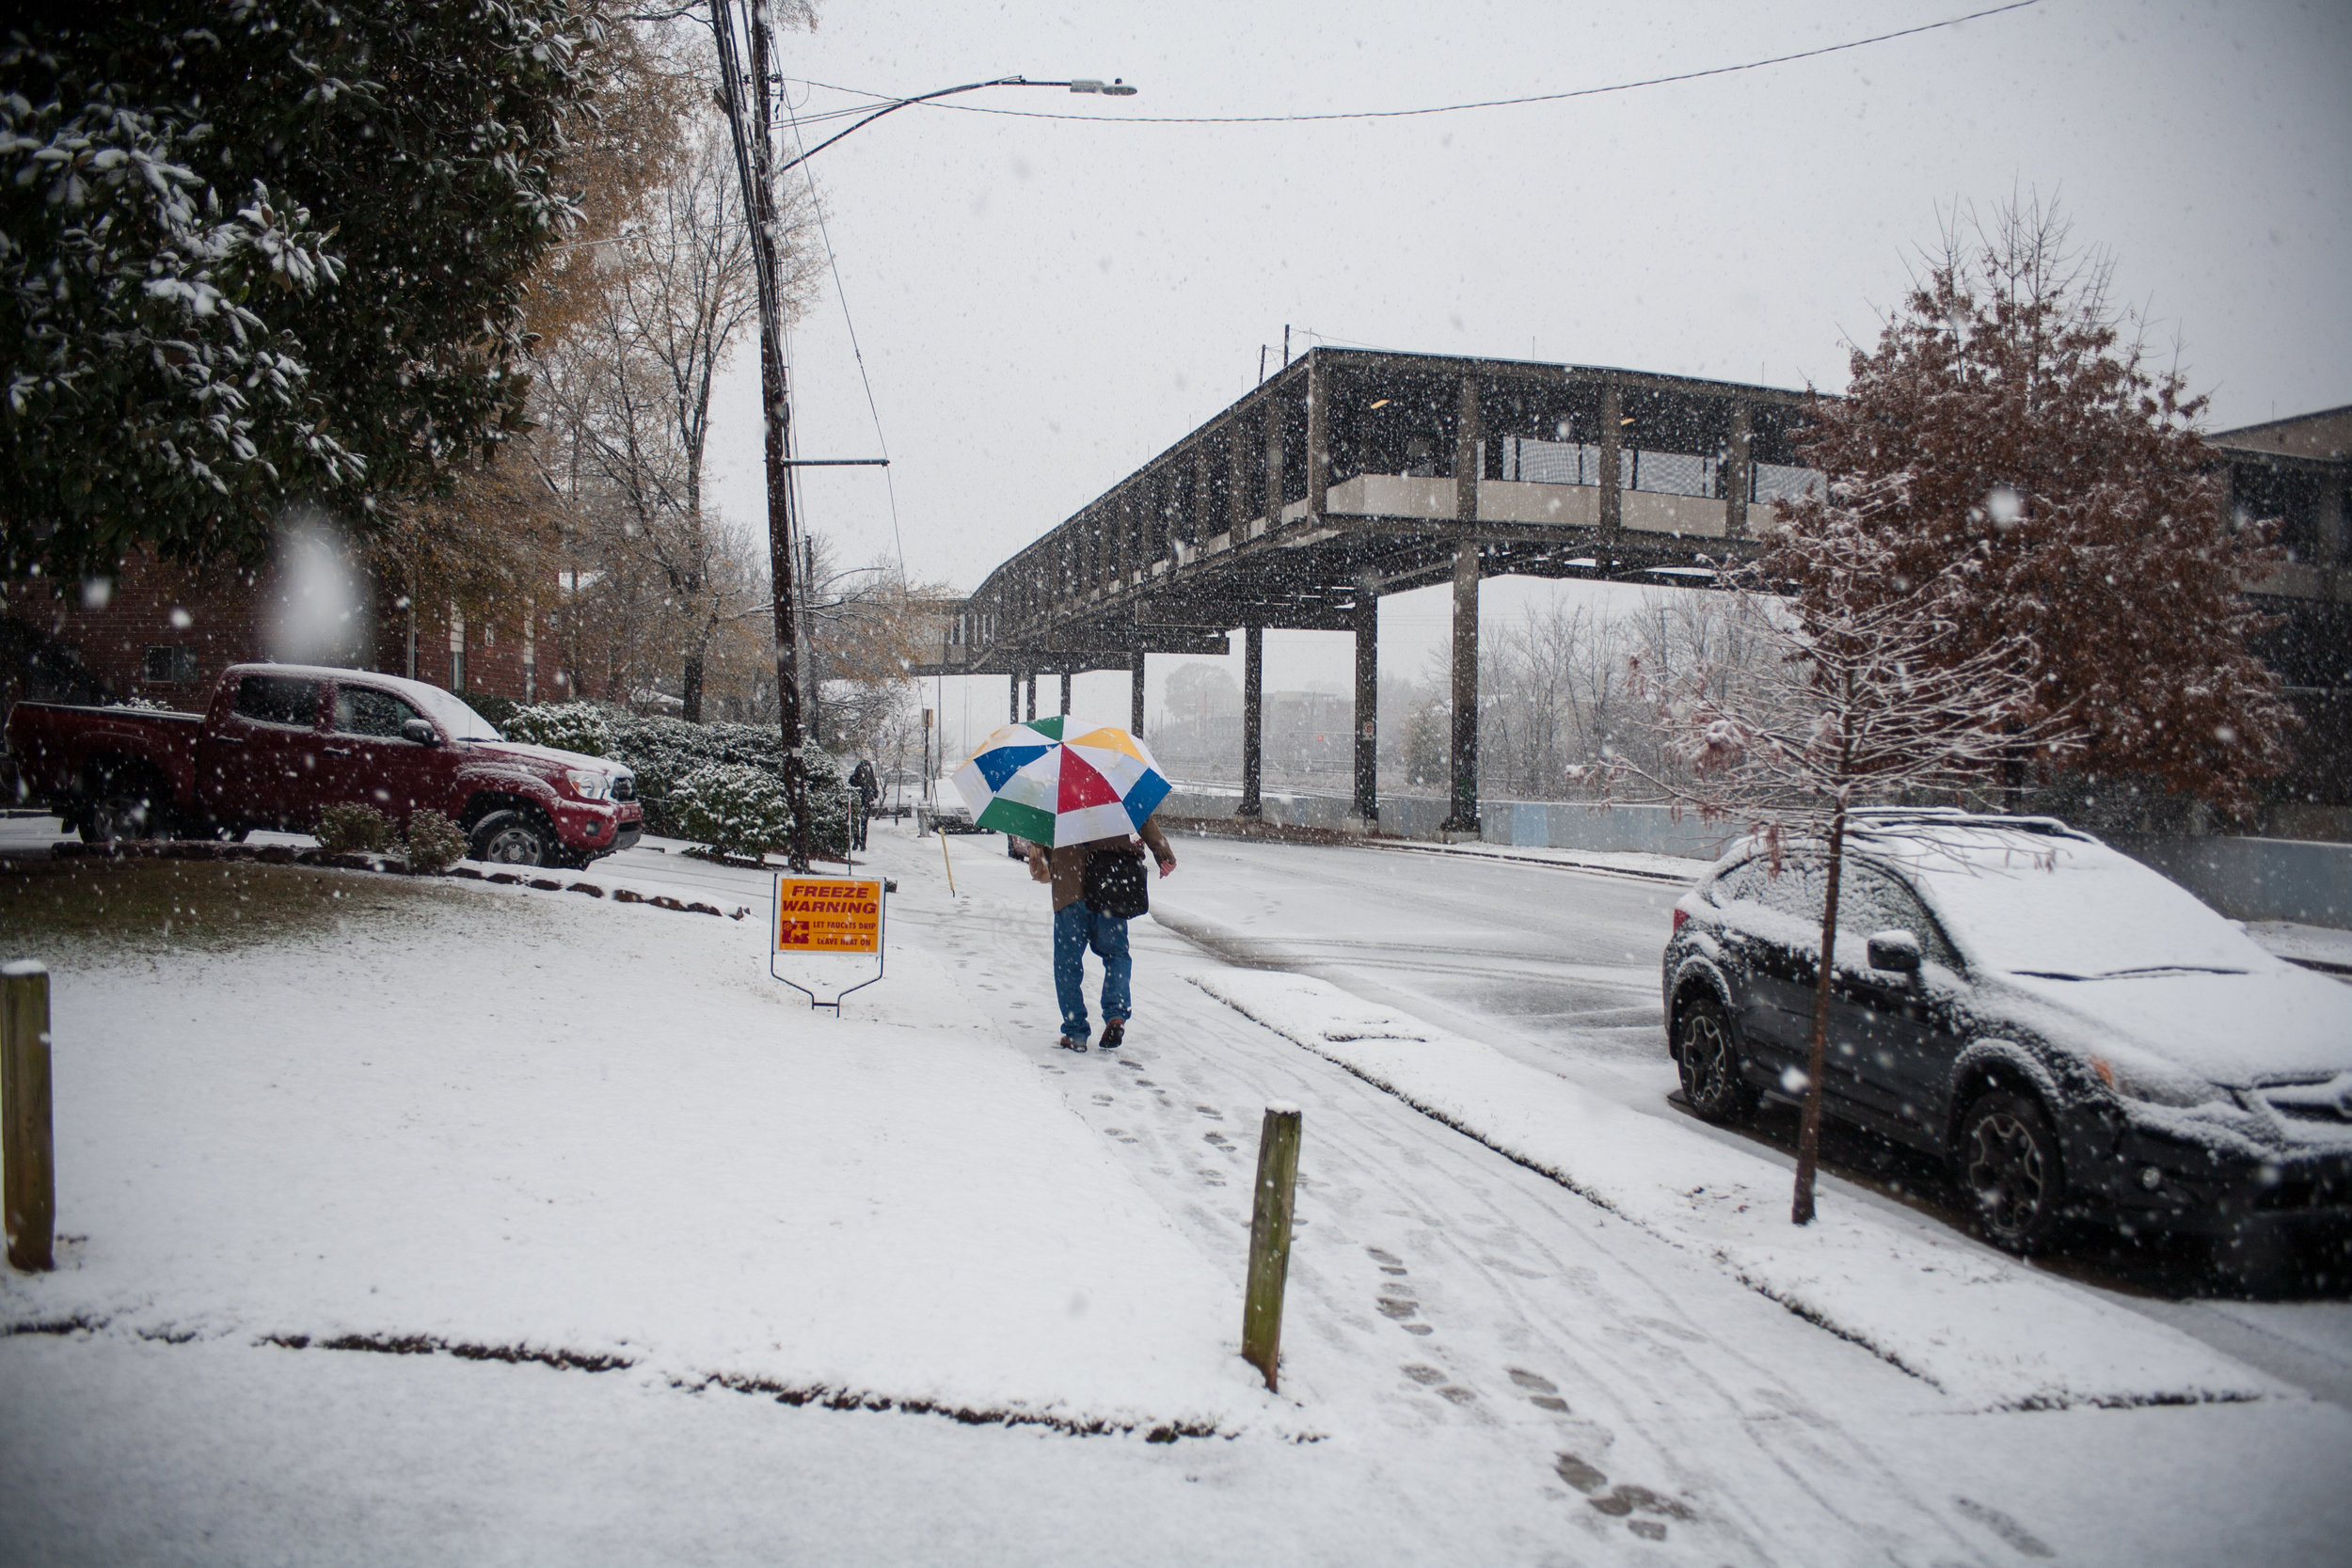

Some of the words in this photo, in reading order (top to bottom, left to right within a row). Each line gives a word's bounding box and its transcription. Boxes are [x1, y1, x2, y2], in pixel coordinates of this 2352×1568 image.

[791, 885, 869, 898] FREEZE
[783, 900, 878, 914] WARNING
[828, 921, 856, 929] FAUCETS
[817, 937, 838, 945] LEAVE
